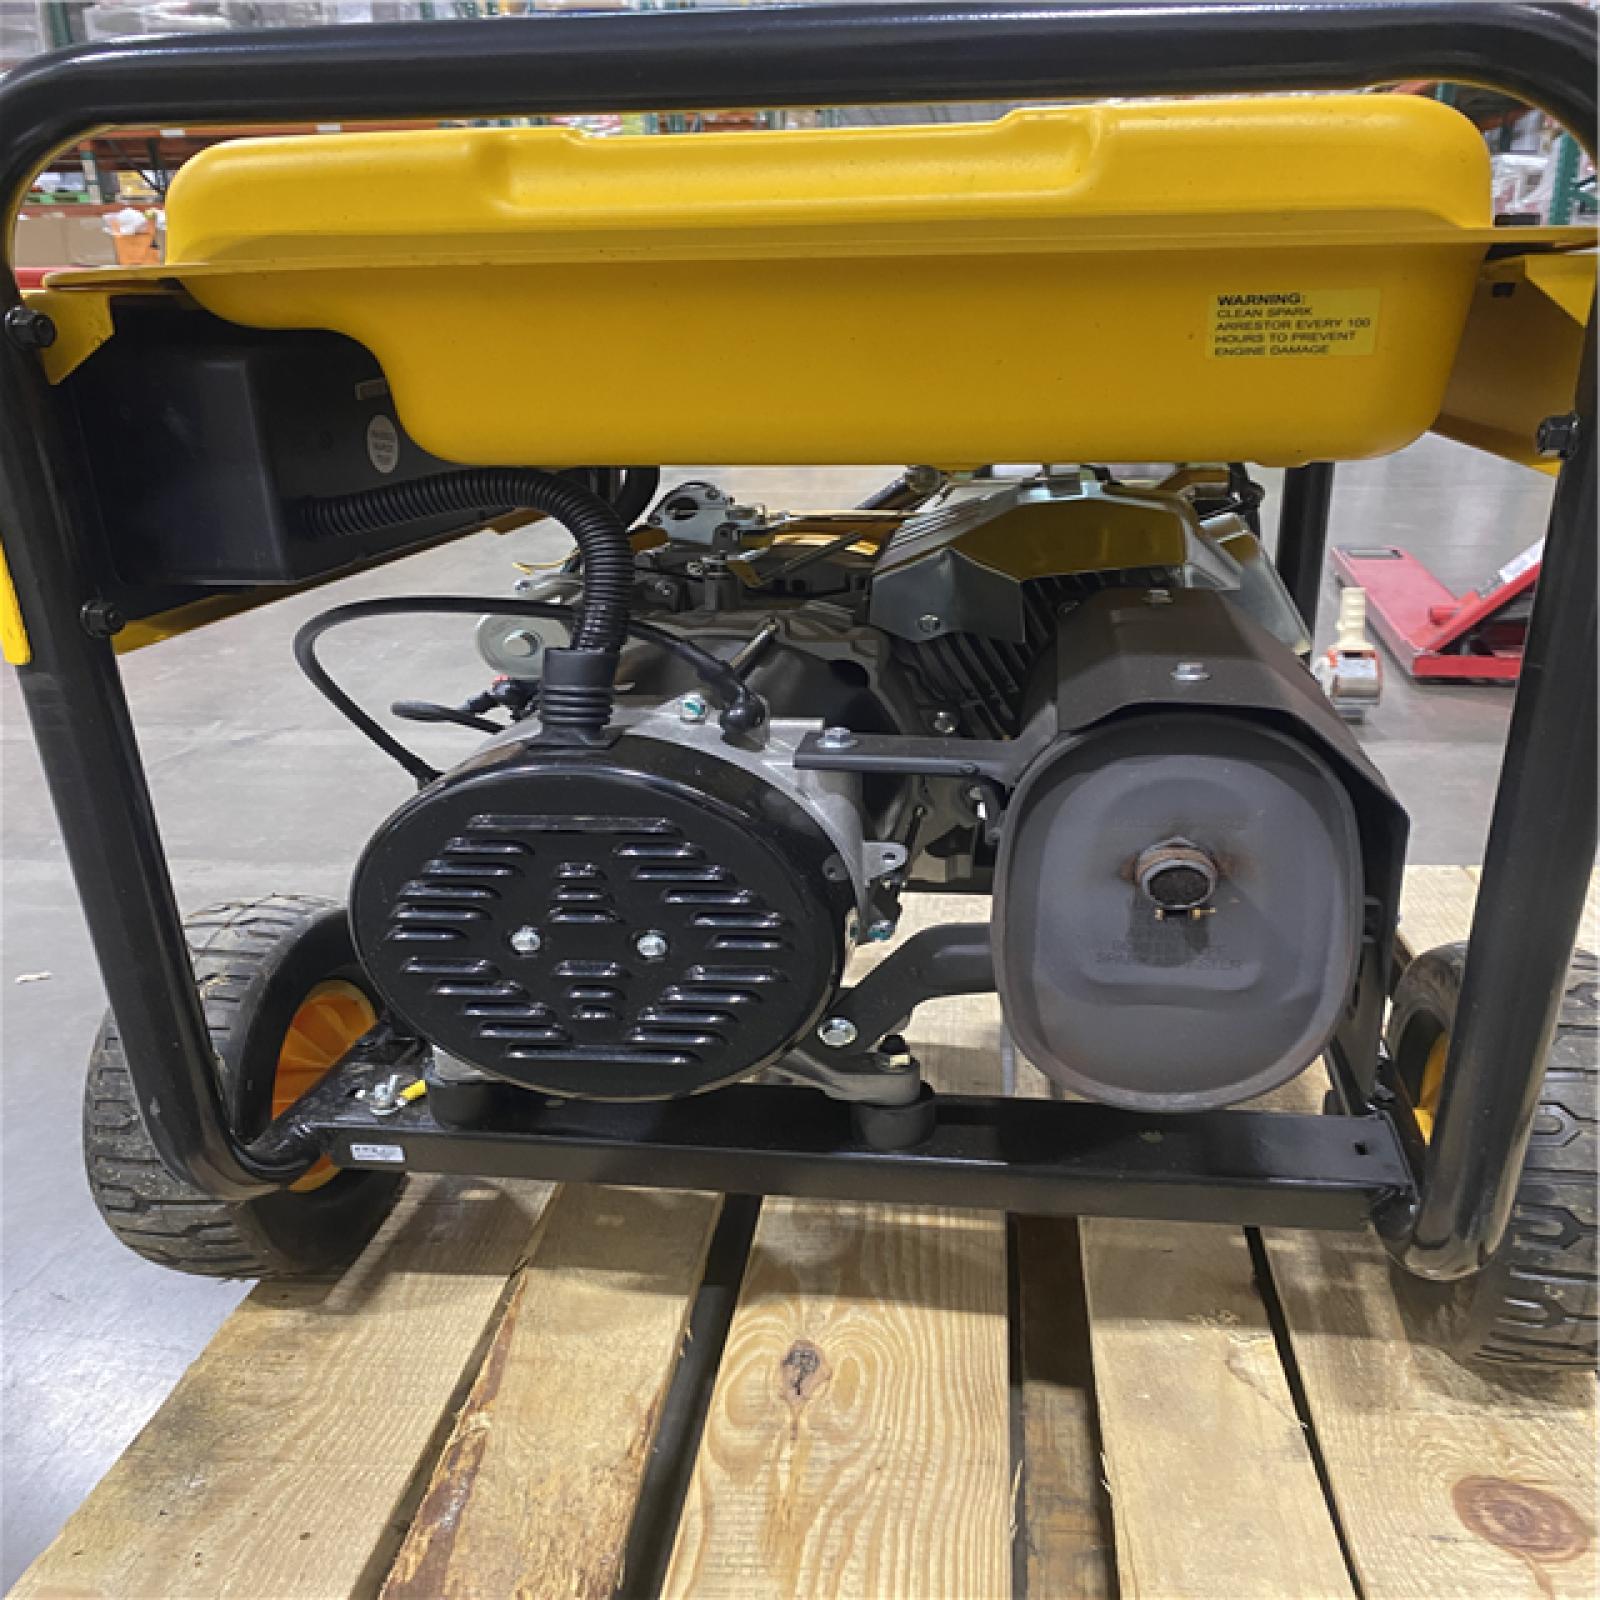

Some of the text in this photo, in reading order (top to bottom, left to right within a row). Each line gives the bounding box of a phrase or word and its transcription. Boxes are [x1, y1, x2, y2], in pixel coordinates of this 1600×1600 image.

[1217, 293, 1305, 305] WARNING:
[1217, 307, 1313, 318] CLEAN SPARK
[1215, 317, 1371, 331] ARRESTOR EVERY 100
[1215, 331, 1356, 343] HOURS TO PREVENT
[1215, 345, 1329, 356] ENGINE DAMAGE
